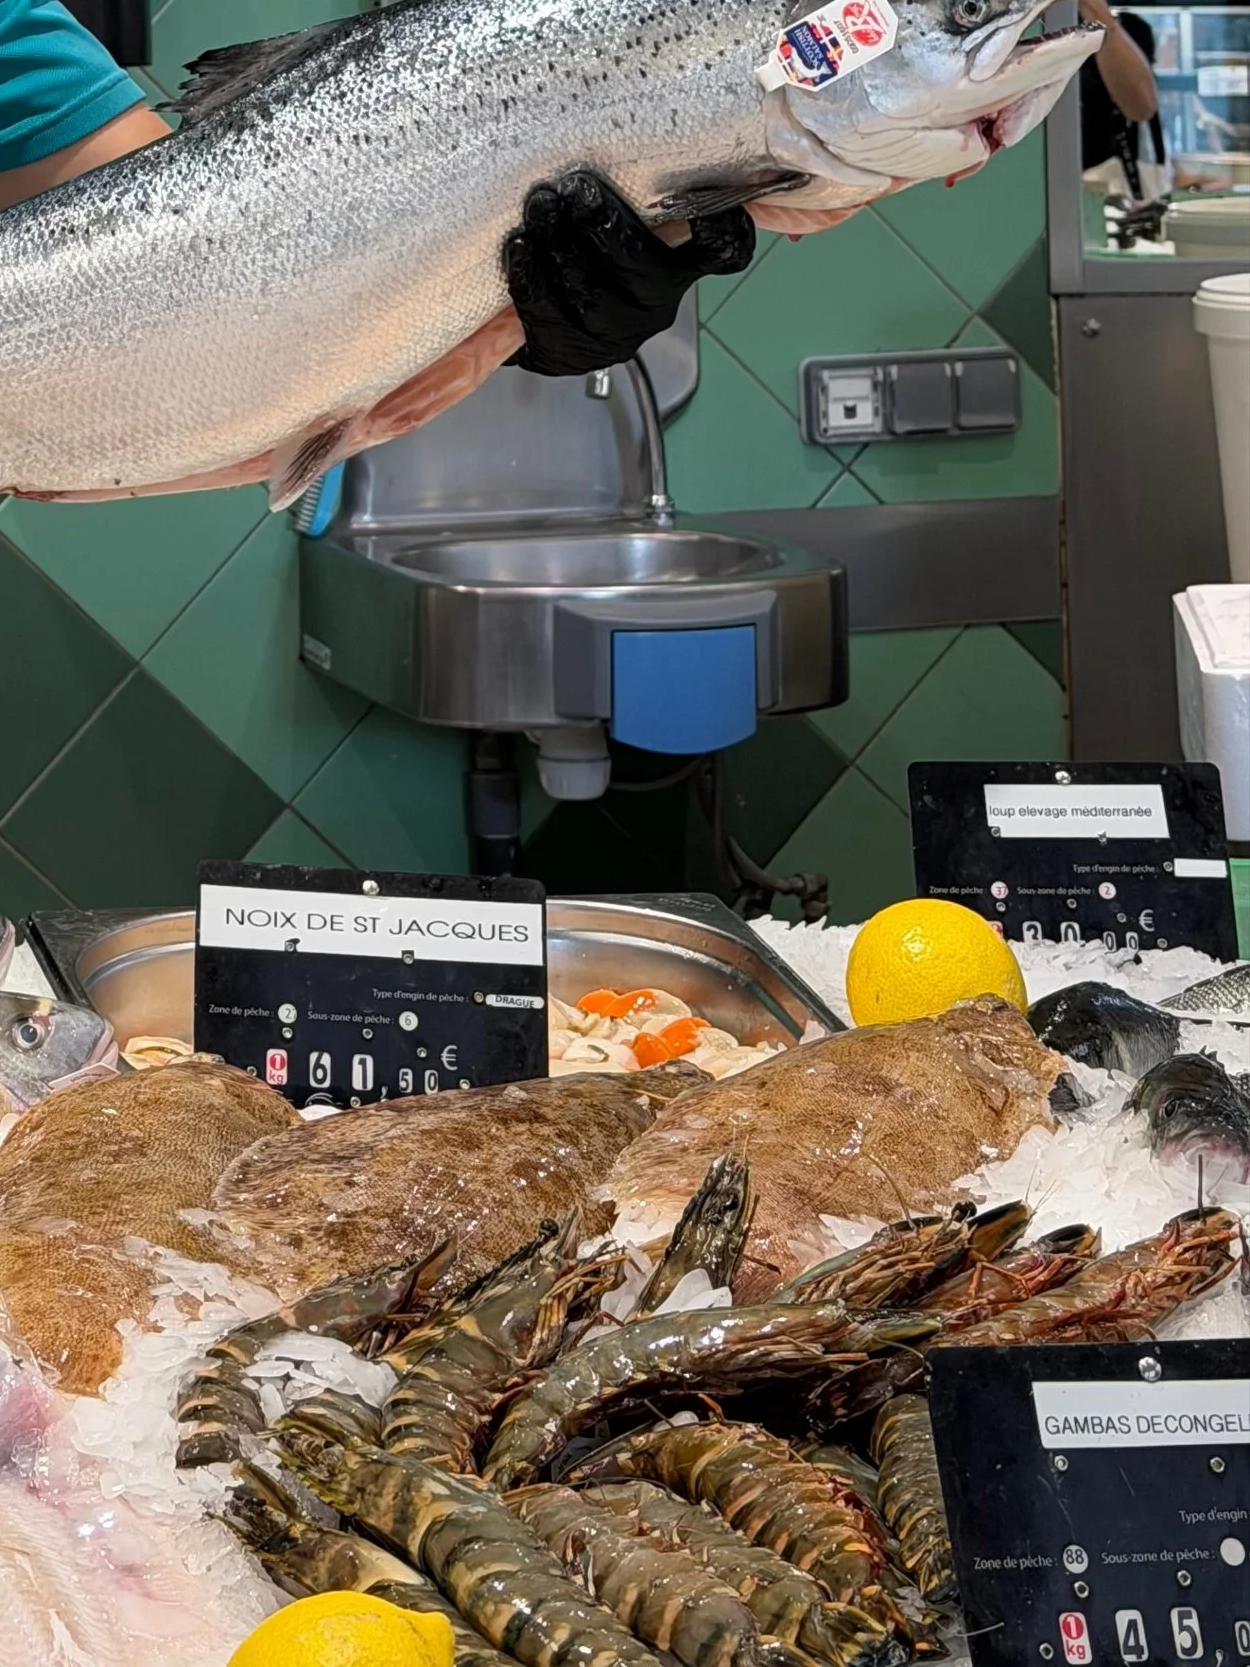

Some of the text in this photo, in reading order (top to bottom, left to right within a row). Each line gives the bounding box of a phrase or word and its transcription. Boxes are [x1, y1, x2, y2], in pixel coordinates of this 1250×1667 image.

[989, 805, 1015, 818] loup
[929, 886, 949, 894] Zone
[225, 908, 529, 942] NOIX DE ST JACQUES
[372, 988, 392, 999] Type
[394, 989, 426, 1001] d'engin
[428, 992, 437, 1000] de
[495, 994, 535, 1008] DRAGUE
[208, 1004, 230, 1015] Zone
[232, 1006, 242, 1016] de
[307, 1011, 351, 1022] Sous-zone
[352, 1014, 363, 1023] de
[405, 1015, 412, 1026] 6
[440, 1045, 458, 1071] €
[269, 1070, 284, 1084] kg
[1044, 1413, 1250, 1435] GAMBAS DECONGEL
[1179, 1506, 1247, 1524] Type d'engin
[973, 1557, 1001, 1570] Zone
[1003, 1556, 1017, 1569] de
[1066, 1549, 1085, 1565] 88
[1101, 1550, 1158, 1564] Sous-zone
[1160, 1549, 1174, 1561] de
[1176, 1548, 1209, 1563] pêche
[1066, 1640, 1086, 1660] kg
